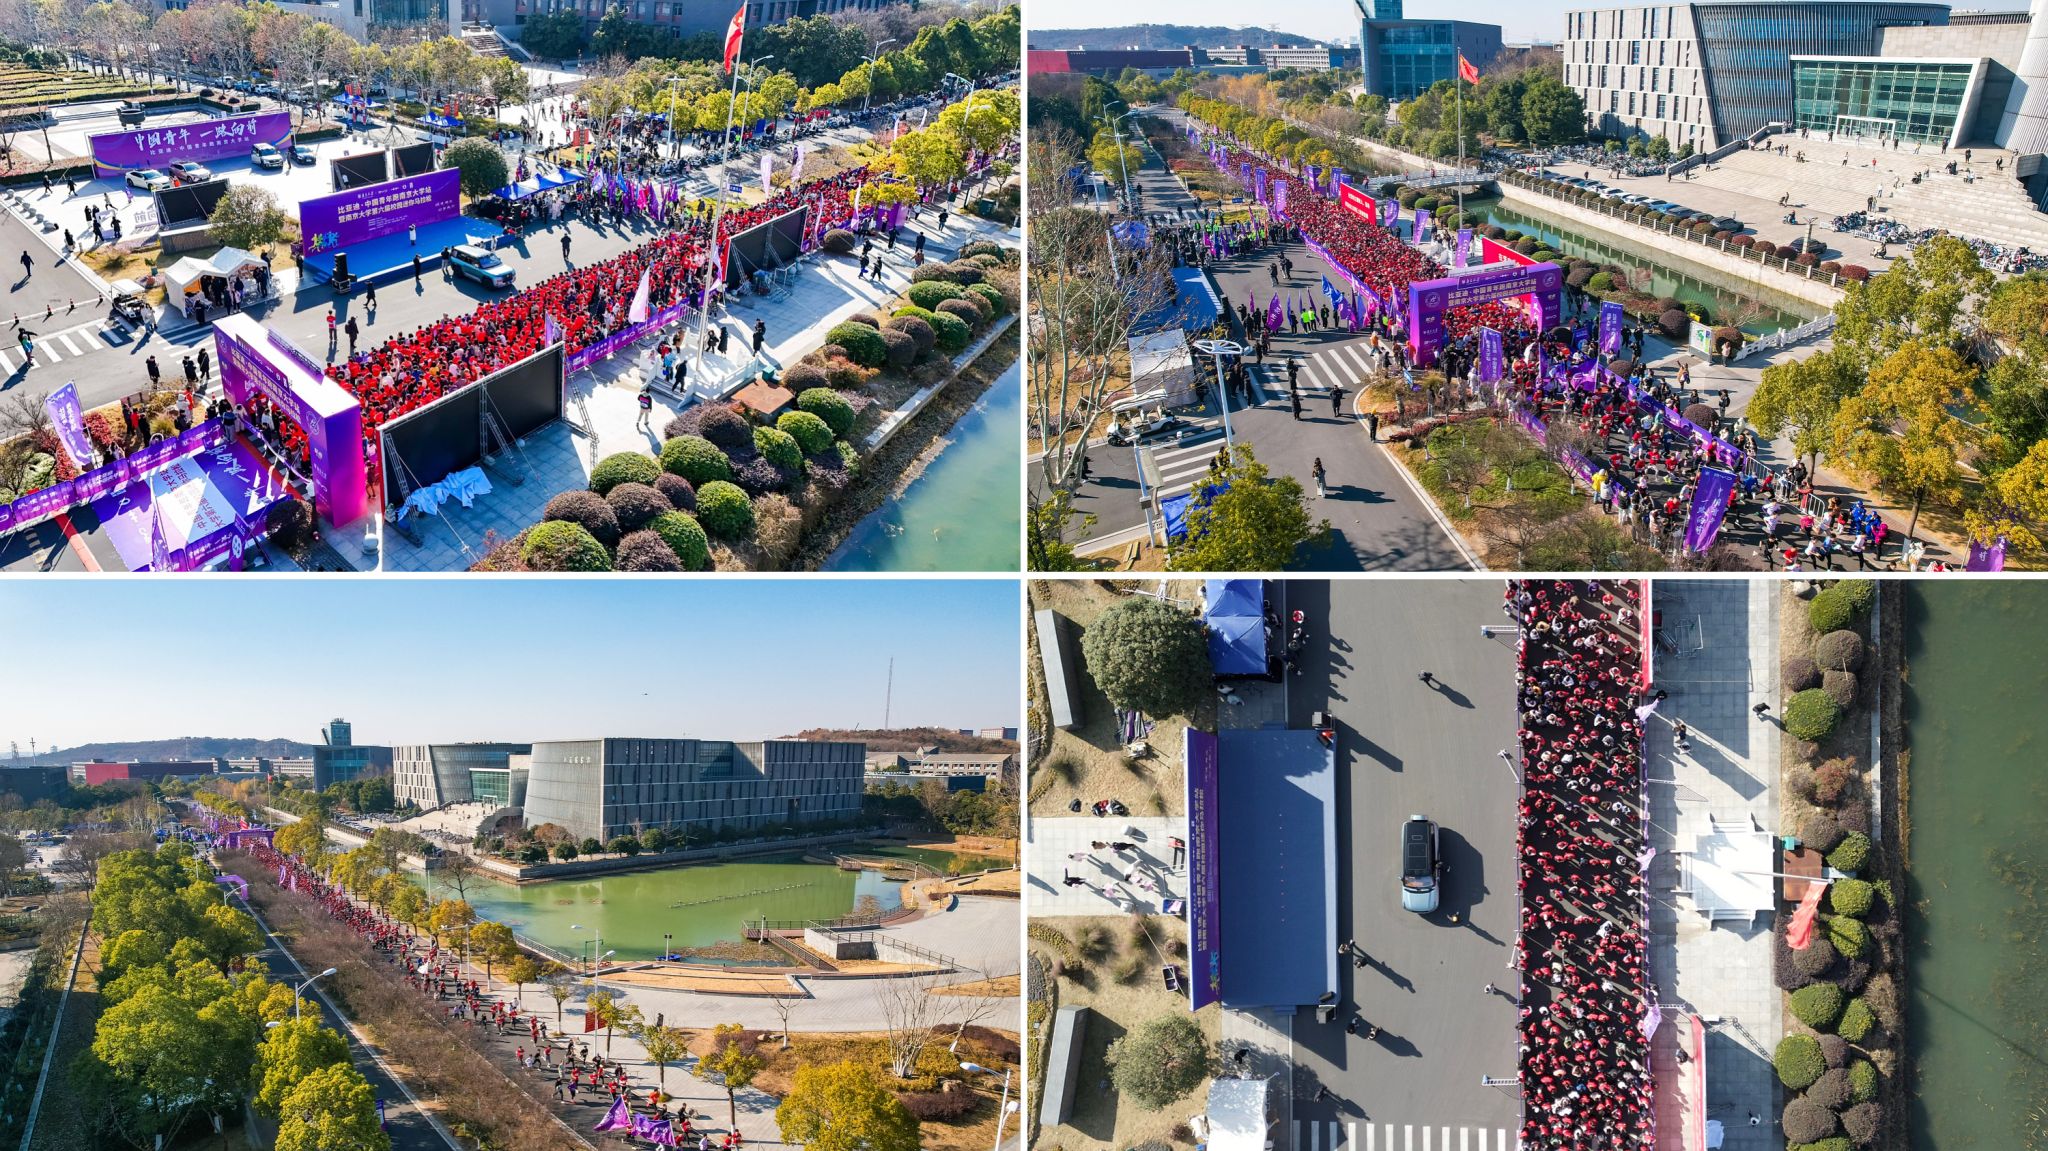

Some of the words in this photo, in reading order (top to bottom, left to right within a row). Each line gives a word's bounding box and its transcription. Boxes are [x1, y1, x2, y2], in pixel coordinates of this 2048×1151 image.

[134, 128, 191, 152] 中国青年
[199, 118, 258, 141] 一路向前
